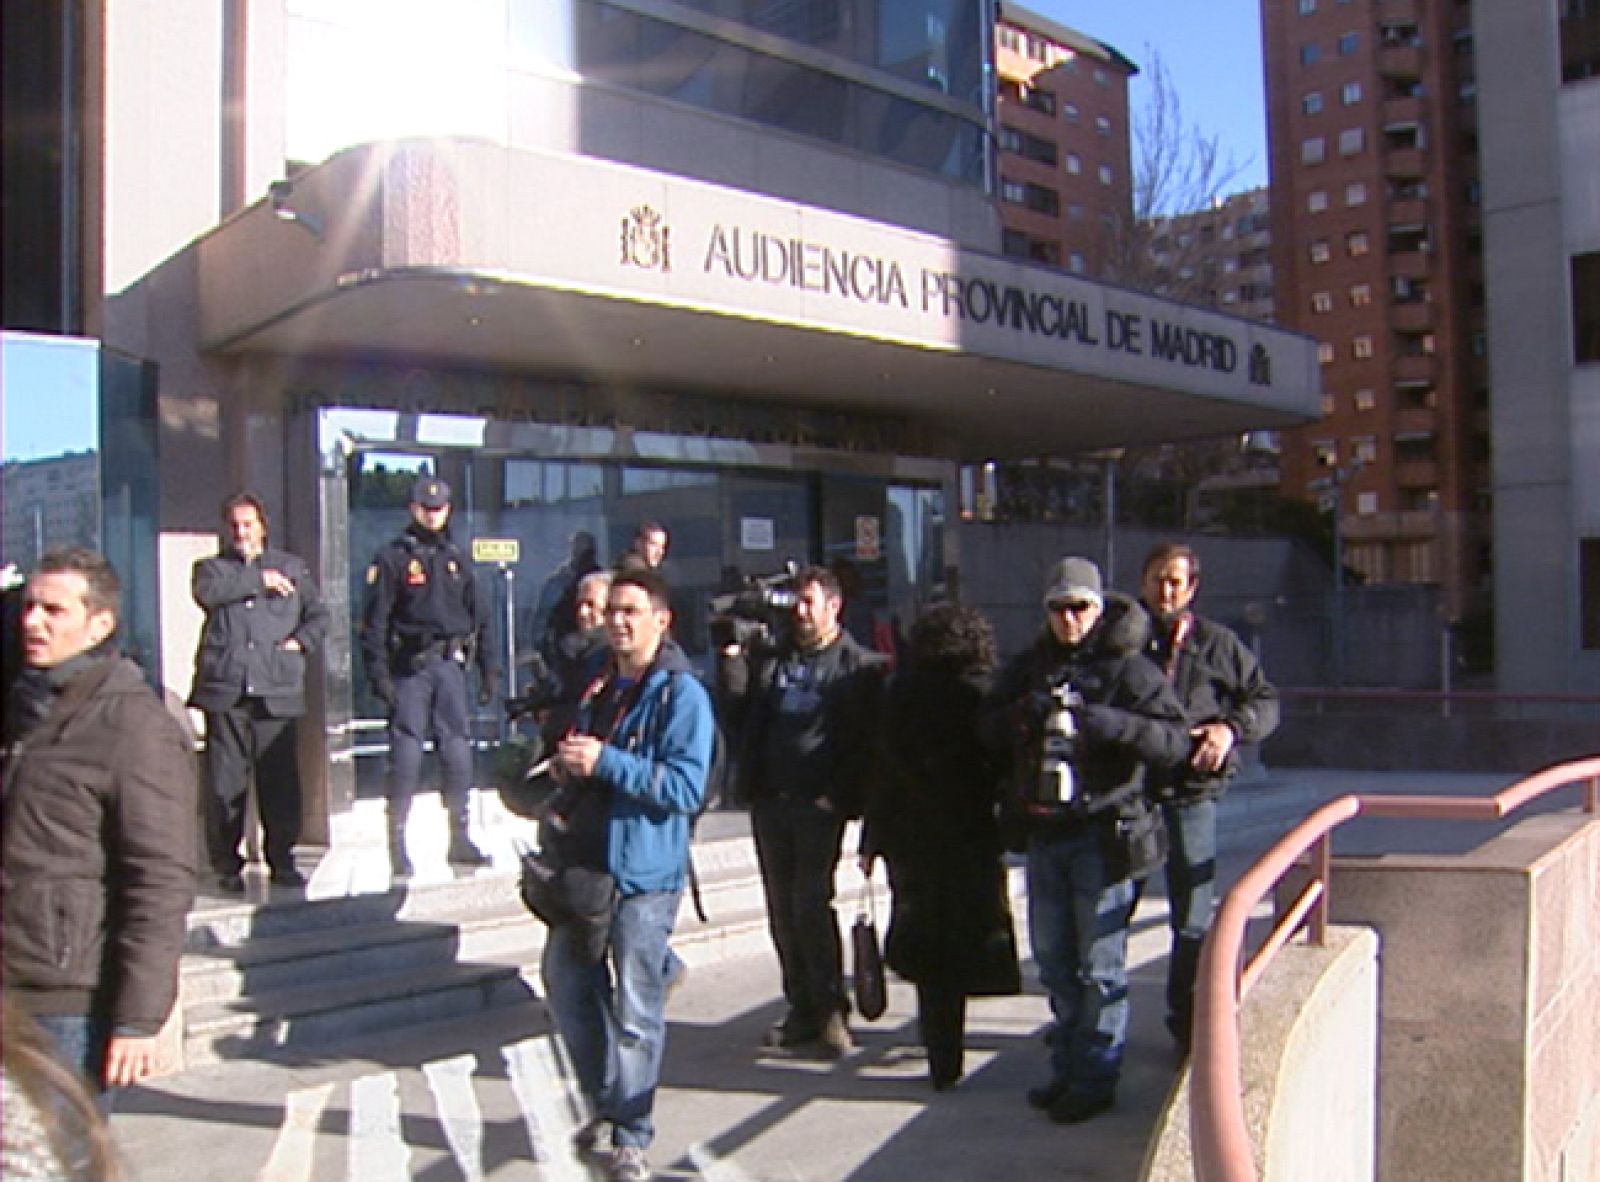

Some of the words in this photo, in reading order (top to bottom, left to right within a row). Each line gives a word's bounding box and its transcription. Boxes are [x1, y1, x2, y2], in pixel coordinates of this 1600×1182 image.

[703, 225, 908, 308] AUDIENCIA
[921, 269, 1098, 345] PROVINCIAL
[1106, 311, 1142, 354] DE
[1150, 320, 1236, 373] MADRID
